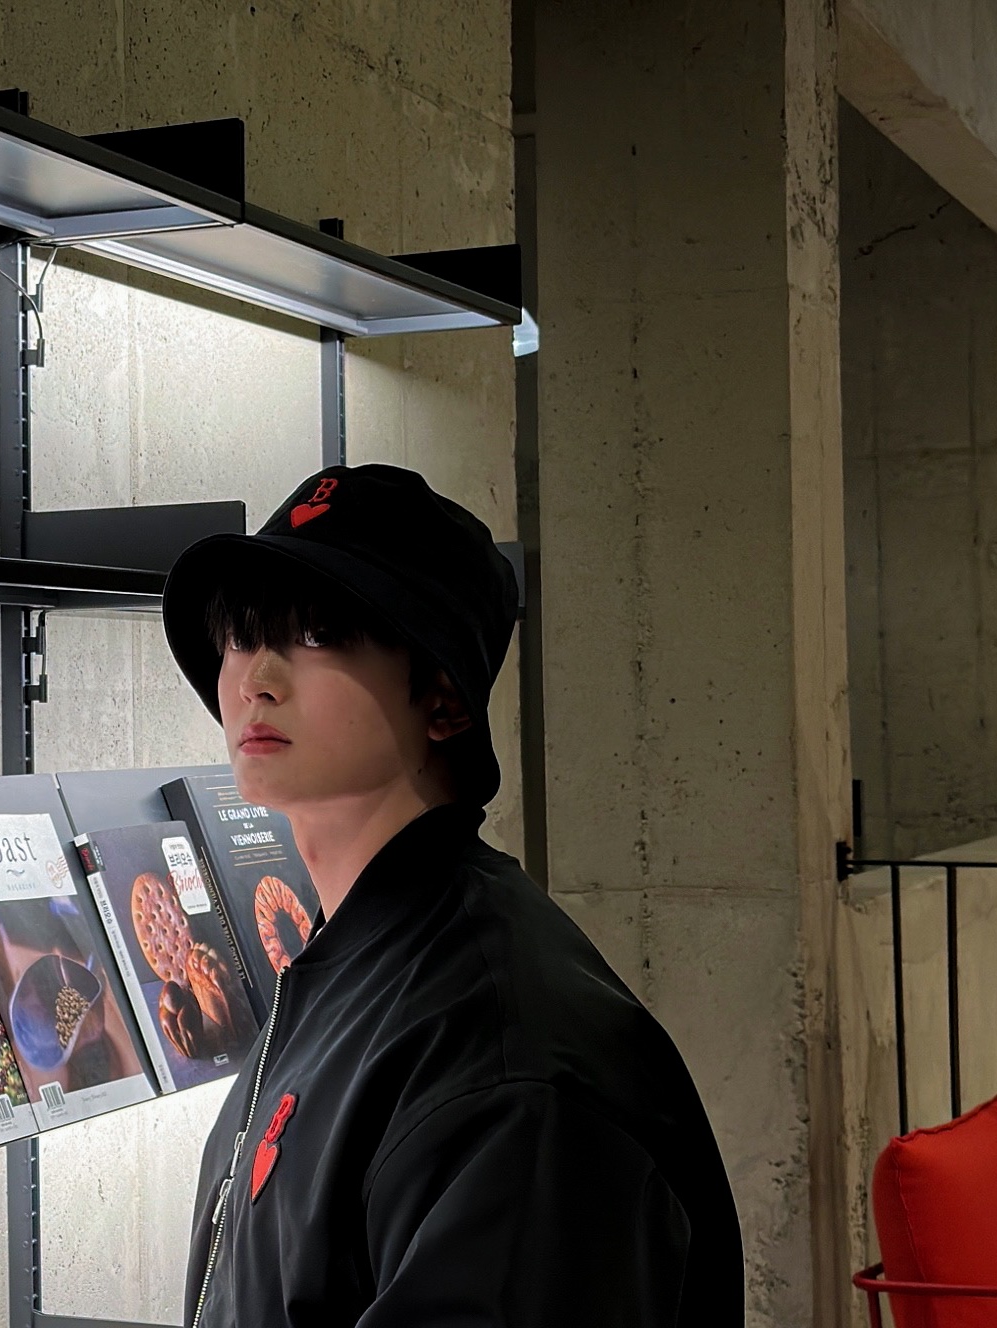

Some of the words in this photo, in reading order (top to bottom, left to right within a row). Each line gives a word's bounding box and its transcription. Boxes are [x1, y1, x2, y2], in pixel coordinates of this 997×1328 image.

[218, 809, 229, 821] LE
[228, 807, 251, 820] GRAND
[250, 806, 269, 818] LIVRE
[230, 831, 275, 846] VIENNOISERIE
[168, 852, 193, 867] 브리오슈
